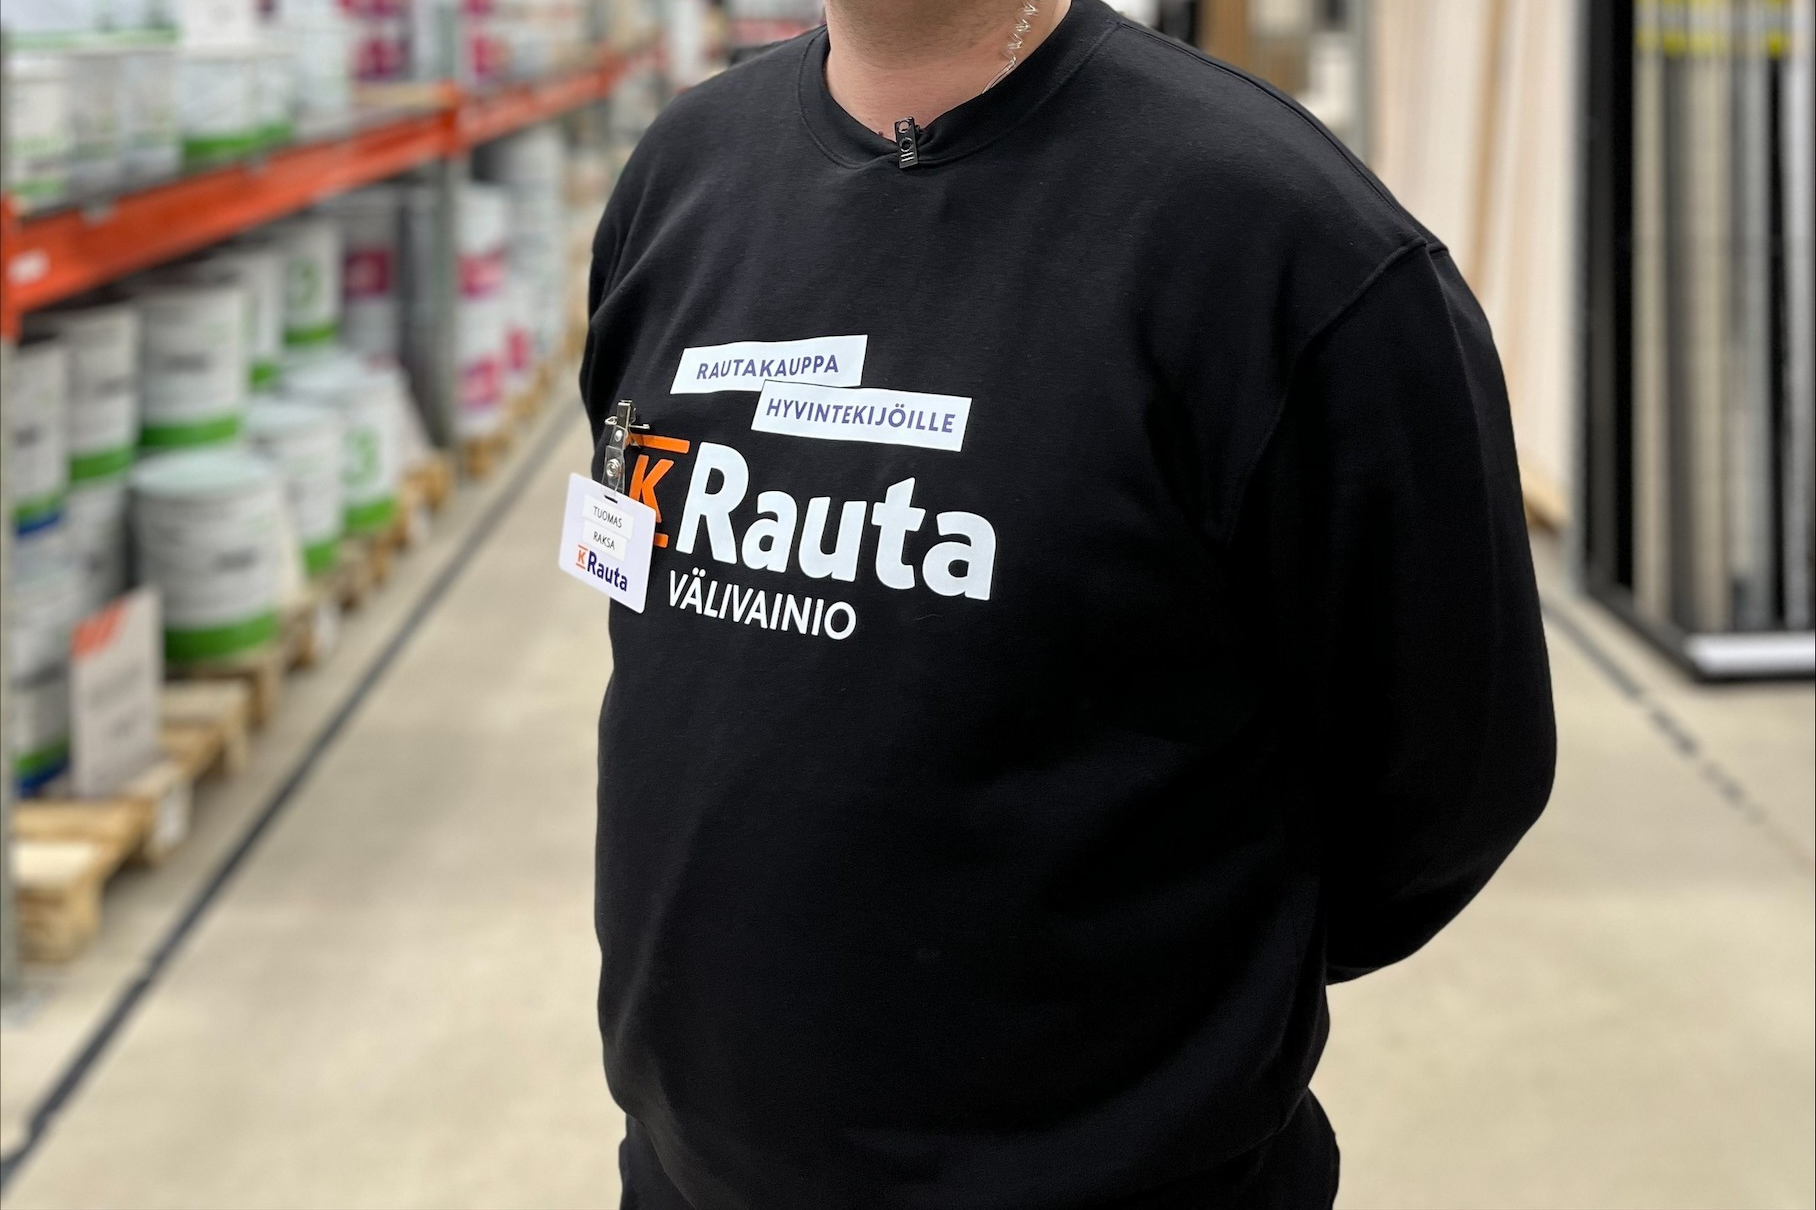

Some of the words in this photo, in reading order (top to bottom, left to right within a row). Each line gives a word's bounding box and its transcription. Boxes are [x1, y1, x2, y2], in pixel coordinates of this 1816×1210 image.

[696, 353, 840, 380] RAUTAKAUPPA
[765, 398, 956, 433] HYVINTEKIJÖILLE
[593, 505, 623, 529] TUOMAS
[675, 441, 997, 601] Rauta
[593, 531, 616, 551] RAKSA
[587, 550, 628, 592] Rauta
[668, 567, 857, 640] VÄLIVAINIO
